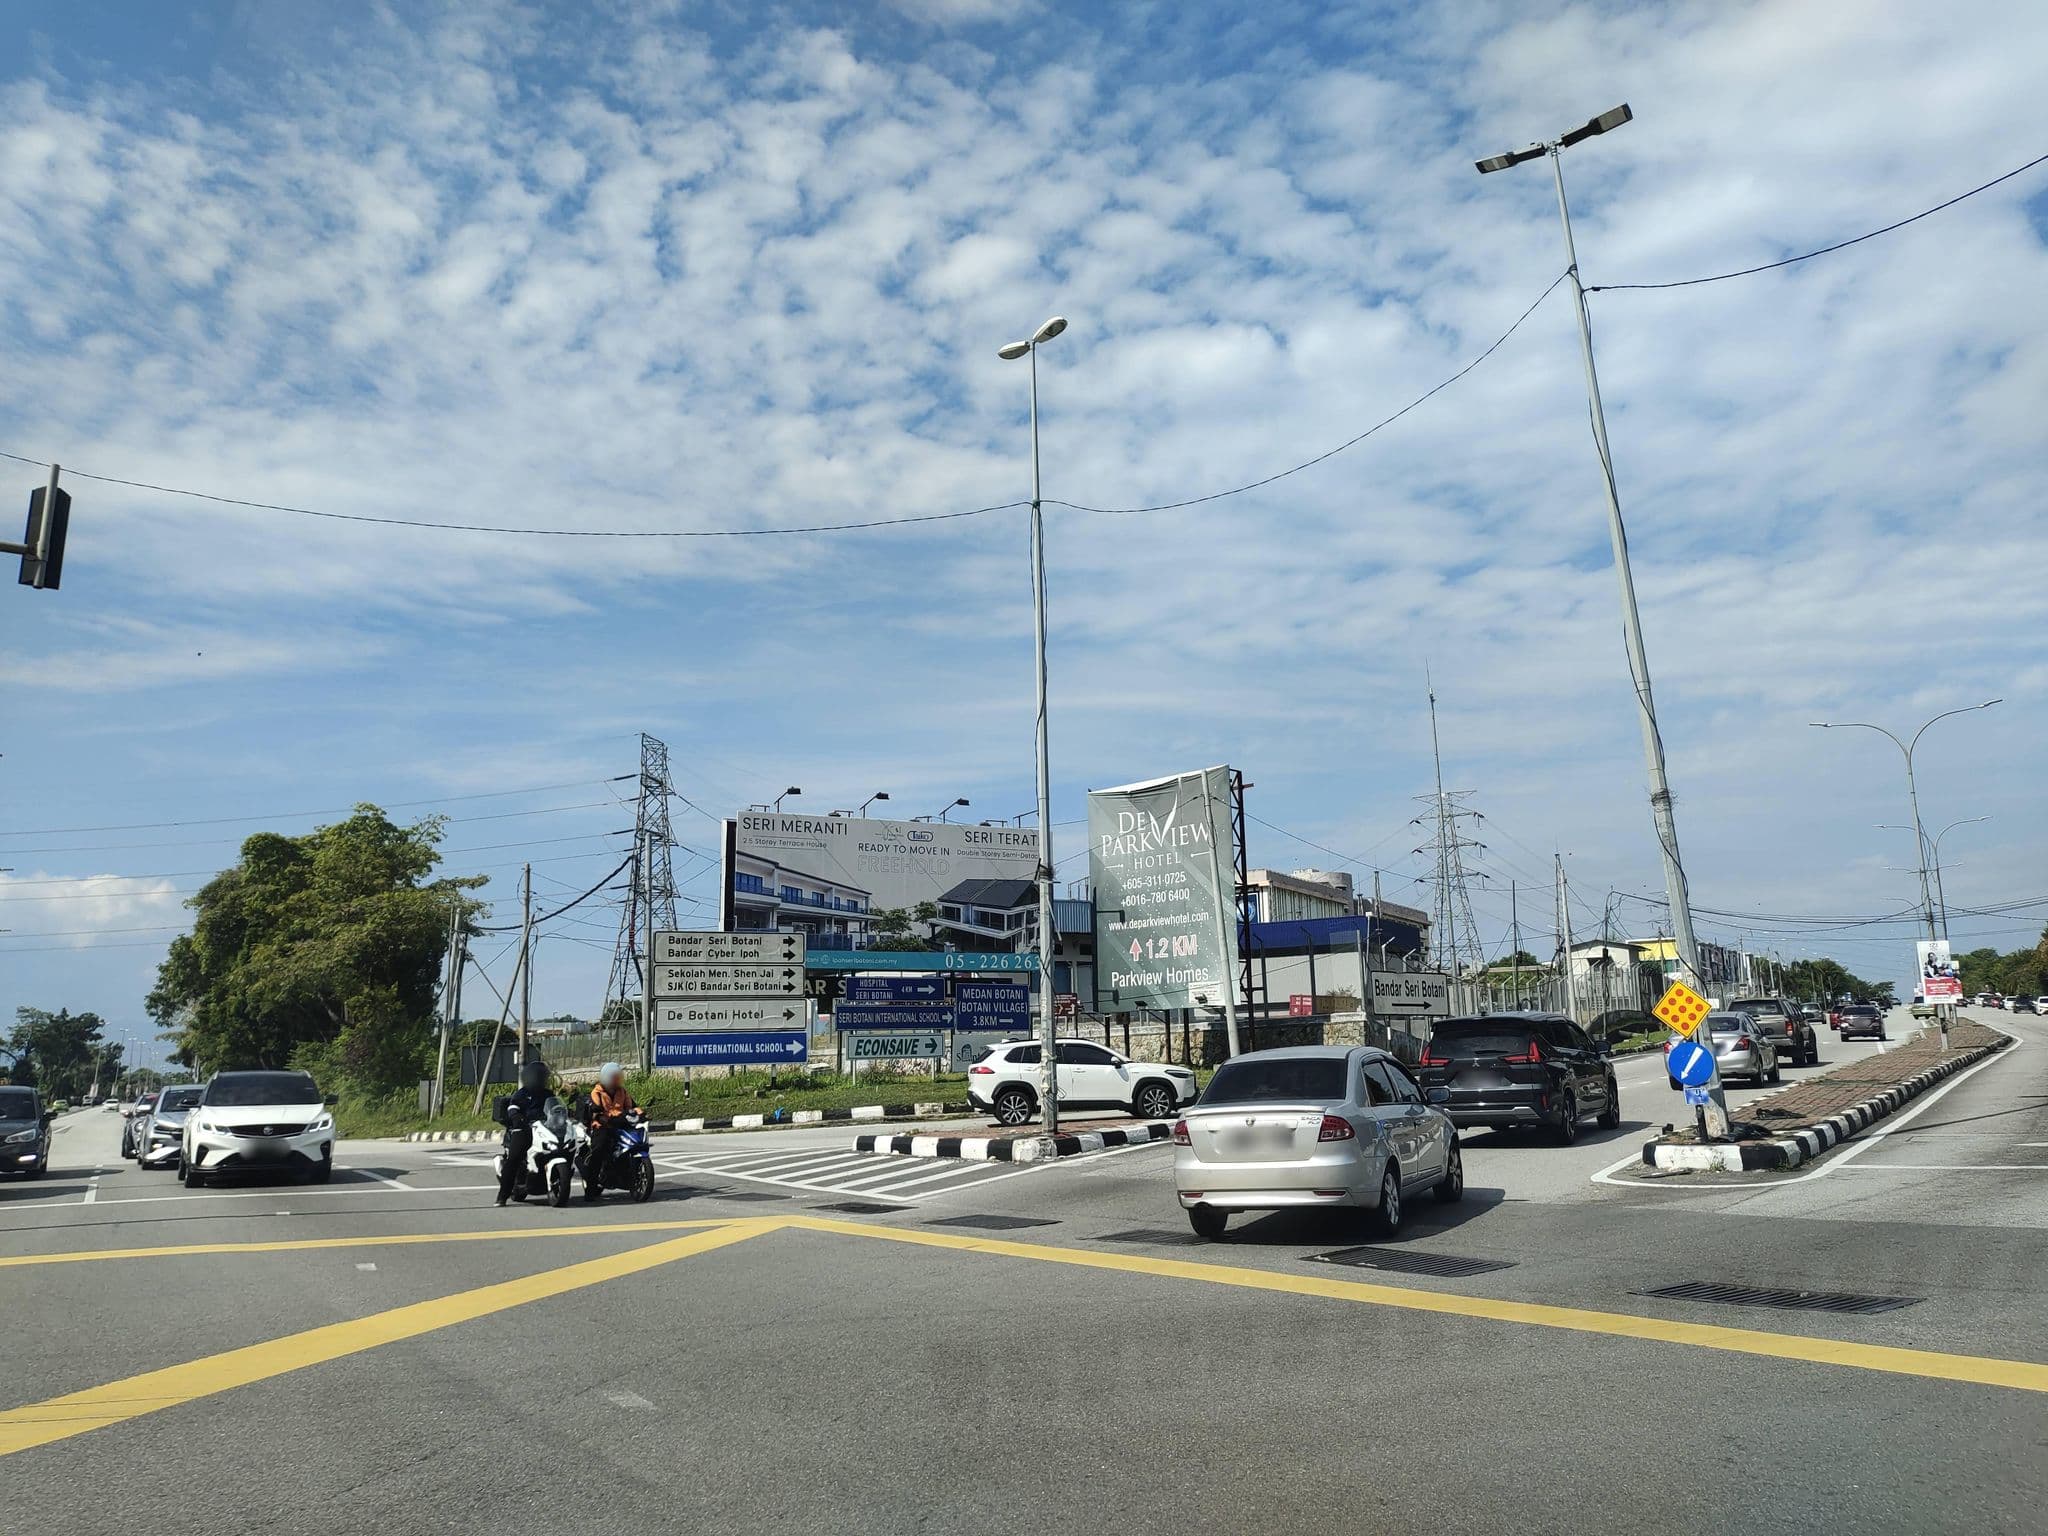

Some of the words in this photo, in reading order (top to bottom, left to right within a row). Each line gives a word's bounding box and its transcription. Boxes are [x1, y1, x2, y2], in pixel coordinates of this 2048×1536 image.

[743, 817, 775, 831] SERI
[781, 820, 848, 836] MERANTI
[1101, 793, 1209, 857] PARKVIEW
[1118, 811, 1146, 834] DE
[755, 838, 777, 848] Storey
[965, 830, 992, 843] SERI
[998, 832, 1039, 847] TERAT
[858, 842, 890, 853] READY
[893, 844, 907, 854] TO
[909, 846, 938, 856] MOVE
[940, 847, 950, 856] IN
[957, 849, 980, 857] Double
[981, 850, 1001, 859] Storey
[857, 854, 950, 876] FREEHOLD
[1134, 851, 1181, 870] HOTEL
[1168, 888, 1190, 901] 6400
[1108, 911, 1209, 931] www.deparkviewhotel.com
[668, 936, 702, 946] Bandar
[708, 936, 727, 945] Seri
[732, 936, 762, 945] Botani
[1146, 937, 1169, 959] 1.2
[1172, 934, 1198, 957] KM
[668, 949, 702, 958] Bandar
[708, 949, 735, 959] Cyber
[740, 950, 760, 959] Ipoh
[668, 969, 705, 978] Sekolah
[708, 969, 730, 978] Men.
[734, 969, 756, 978] Shen
[759, 969, 774, 978] Jai
[1111, 970, 1163, 988] Parkview
[1166, 967, 1209, 984] Homes
[667, 982, 697, 992] SJK(C)
[700, 982, 731, 991] Bandar
[734, 982, 750, 991] Seri
[753, 981, 781, 991] Botani
[859, 979, 889, 988] HOSPITAL
[1375, 979, 1402, 998] Bandar
[1404, 980, 1420, 998] Seri
[1422, 981, 1445, 998] Botani
[855, 991, 870, 1000] SERI
[871, 991, 893, 1000] BOTANI
[962, 988, 993, 999] MEDAN
[994, 989, 1024, 1000] BOTANI
[667, 1010, 683, 1020] De
[688, 1010, 728, 1020] Botani
[732, 1009, 764, 1019] Hotel
[958, 1001, 991, 1014] (BOTANI
[993, 1002, 1028, 1015] VILLAGE)
[838, 1012, 853, 1024] SERI
[854, 1012, 873, 1023] BOTANI
[874, 1012, 918, 1023] INTERNATIONAL
[919, 1012, 940, 1022] SCHOOL
[972, 1016, 998, 1027] 3.8KM
[658, 1045, 693, 1056] FAIRVIEW
[696, 1043, 753, 1054] INTERNATIONAL
[755, 1042, 784, 1053] SCHOOL
[855, 1039, 920, 1057] ECONSAVE
